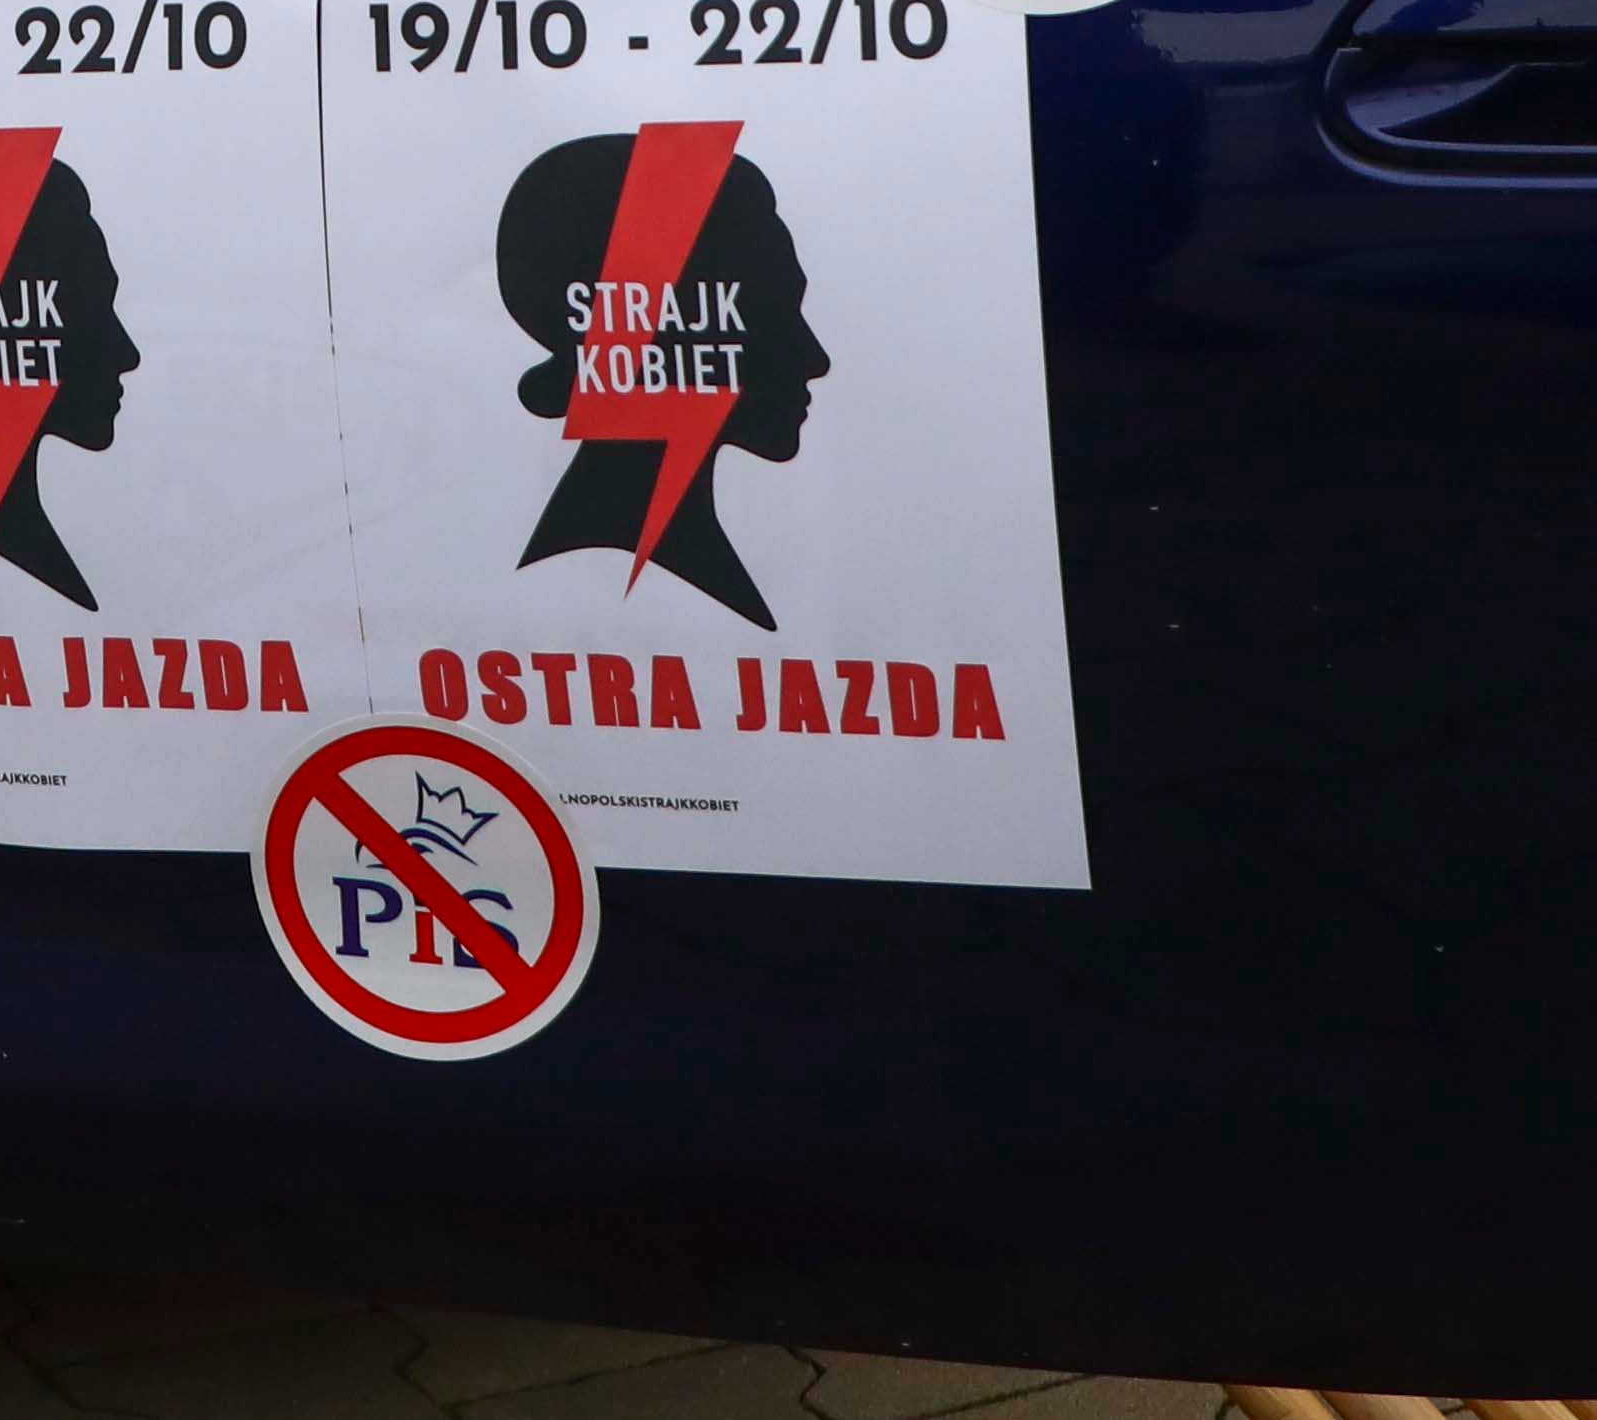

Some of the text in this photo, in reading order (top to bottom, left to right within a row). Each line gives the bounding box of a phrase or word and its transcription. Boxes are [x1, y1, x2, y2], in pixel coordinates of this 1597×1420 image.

[628, 36, 649, 50] -
[567, 282, 746, 333] STRAJK
[577, 344, 744, 395] KOBIET
[63, 637, 309, 713] JAZDA
[418, 648, 1005, 740] OSTRA JAZDA
